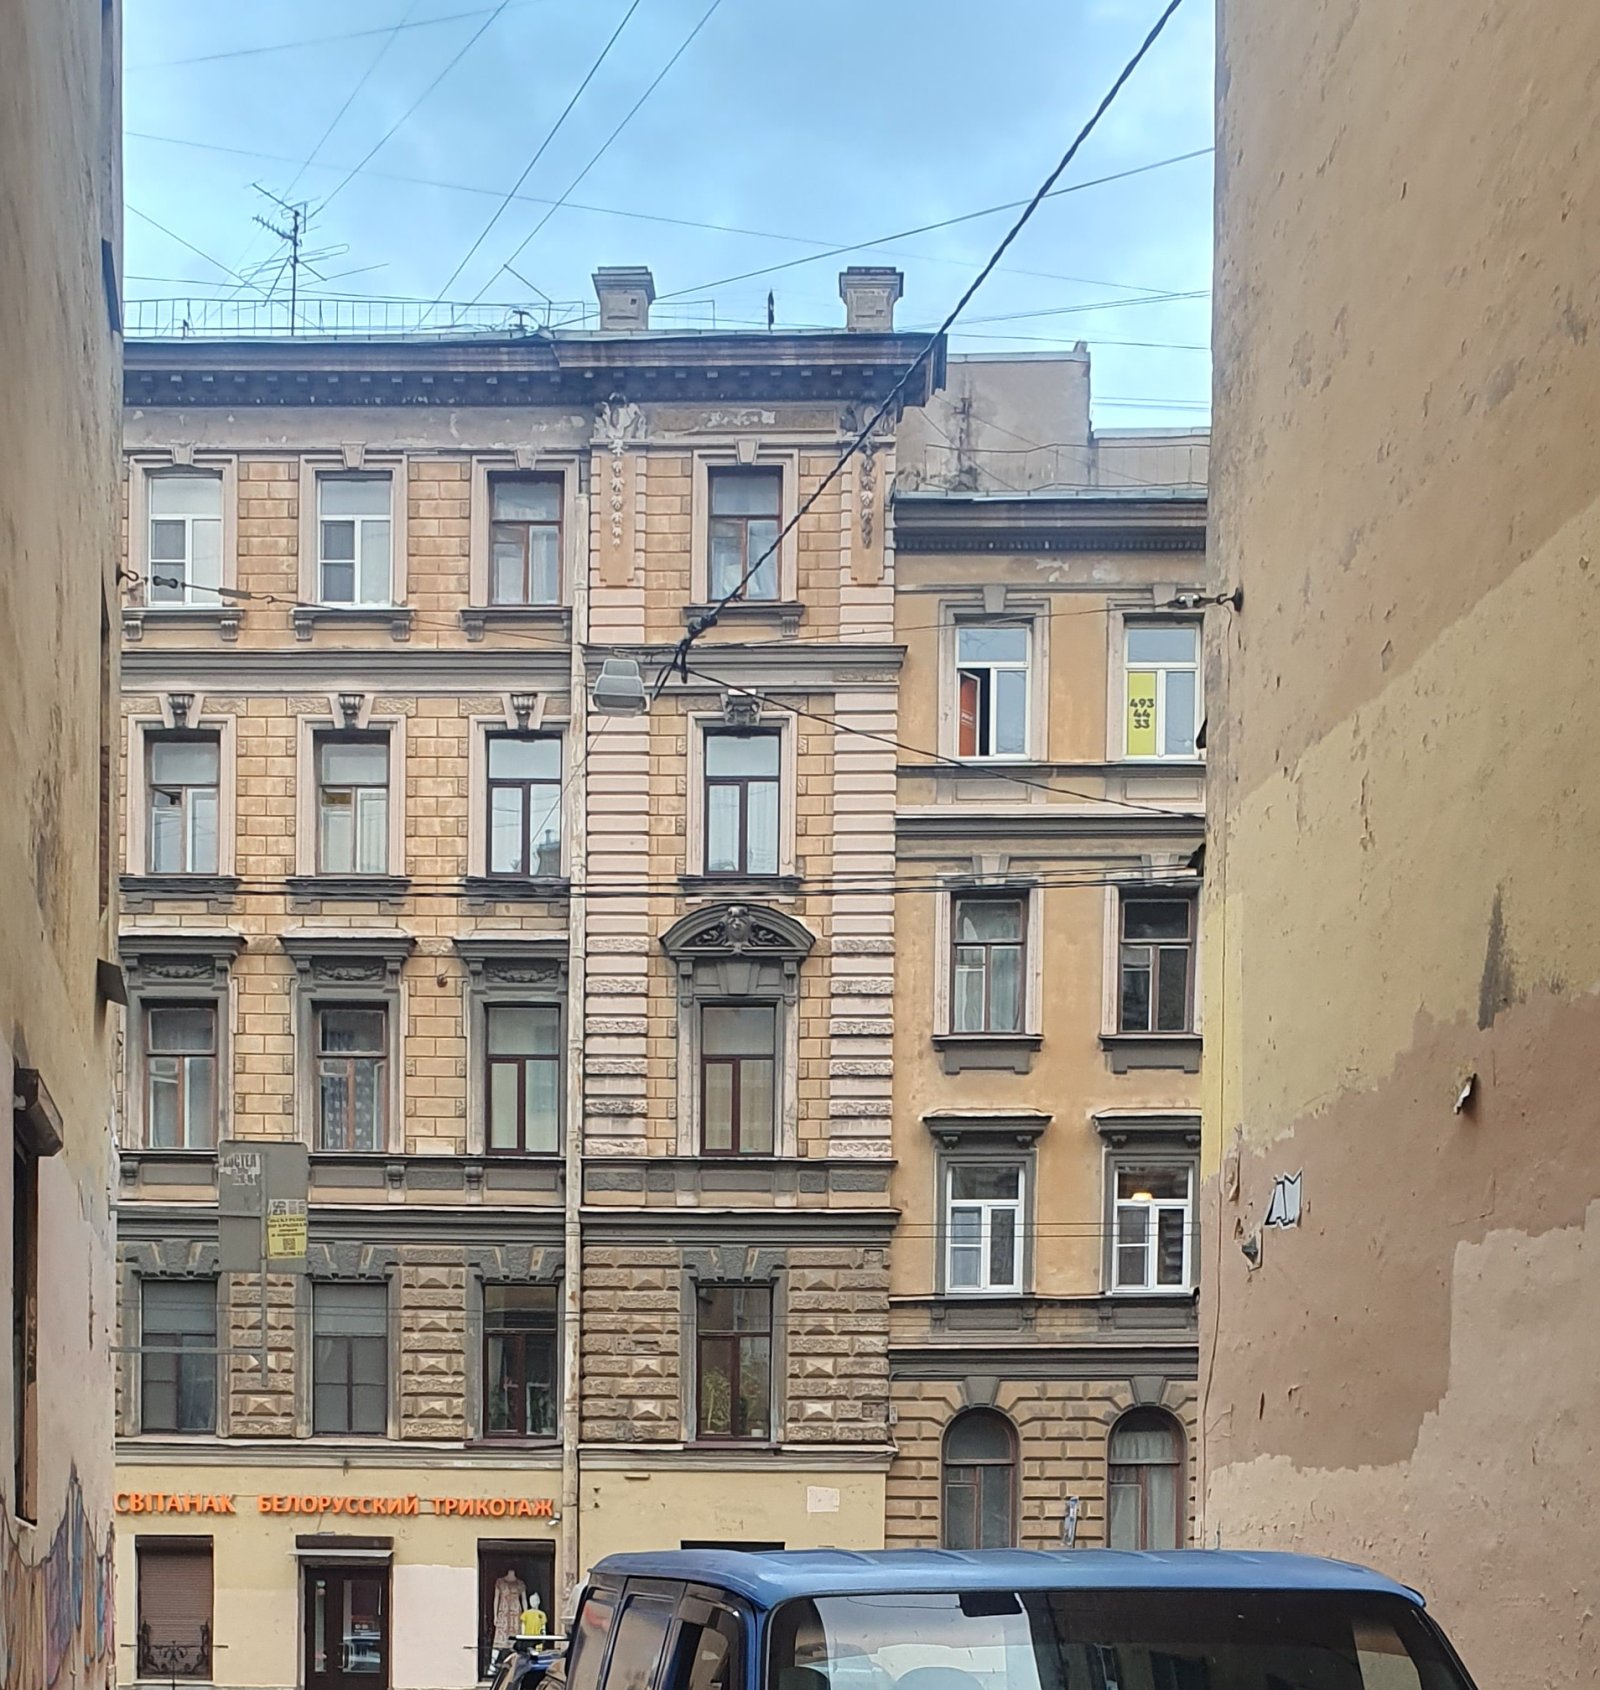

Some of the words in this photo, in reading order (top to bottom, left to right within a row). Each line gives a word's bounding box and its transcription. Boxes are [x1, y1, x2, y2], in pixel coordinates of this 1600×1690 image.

[1129, 698, 1155, 708] 493
[1133, 708, 1151, 719] 44
[1134, 719, 1150, 729] 33
[114, 1492, 236, 1514] СВІТАНАК
[257, 1493, 420, 1516] БЕЛОРУССКИЙ
[431, 1497, 554, 1517] ТРИКОТАЖ
